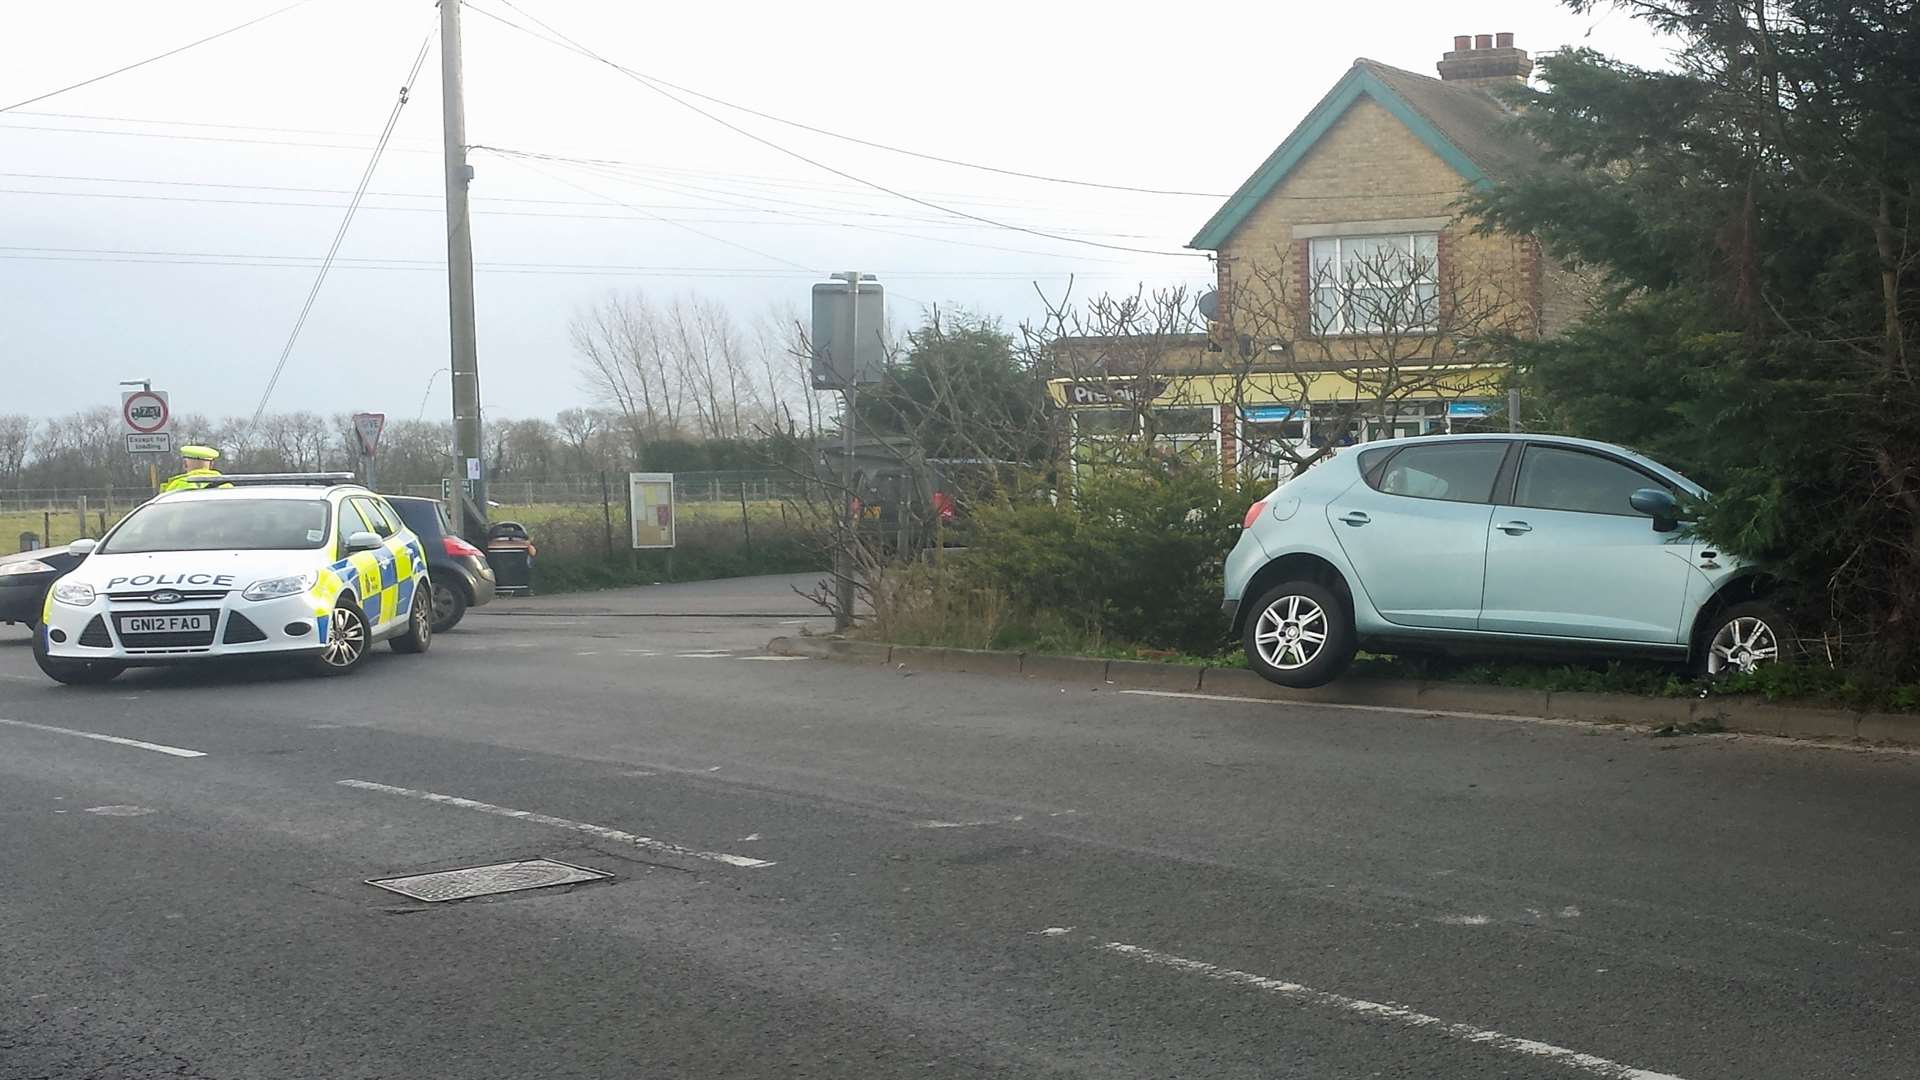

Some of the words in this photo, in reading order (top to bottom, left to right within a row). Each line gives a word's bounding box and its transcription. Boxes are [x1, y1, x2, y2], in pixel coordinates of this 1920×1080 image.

[1073, 386, 1147, 403] Premi
[129, 436, 153, 444] Except
[107, 574, 235, 589] POLICE
[130, 618, 165, 631] GN12
[170, 617, 200, 630] FAO
